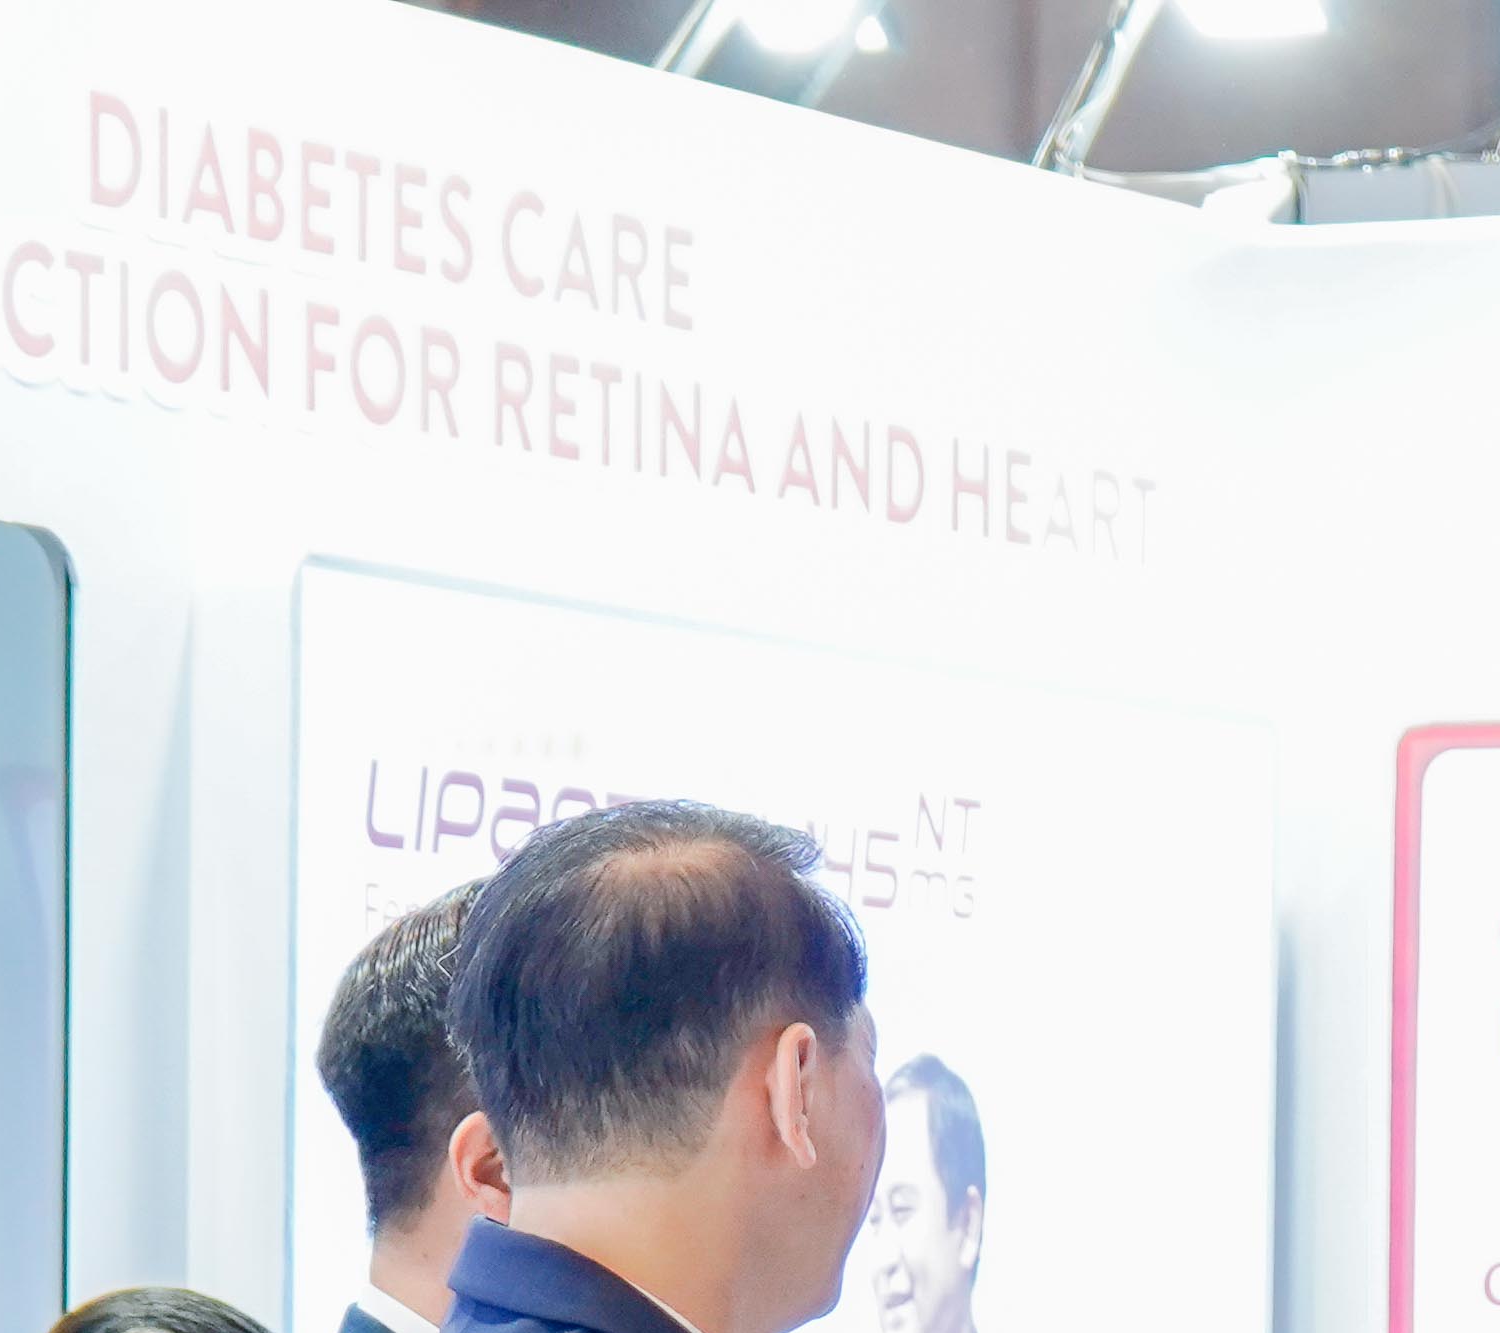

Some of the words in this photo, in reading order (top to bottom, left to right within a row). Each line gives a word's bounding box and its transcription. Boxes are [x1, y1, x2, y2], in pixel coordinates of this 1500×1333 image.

[90, 89, 474, 286] DIABETES
[501, 188, 695, 332] CARE
[305, 299, 461, 441] FOR
[494, 338, 757, 498] RETINA
[778, 409, 926, 527] AND
[951, 436, 1158, 567] HEART
[916, 791, 983, 855] NT
